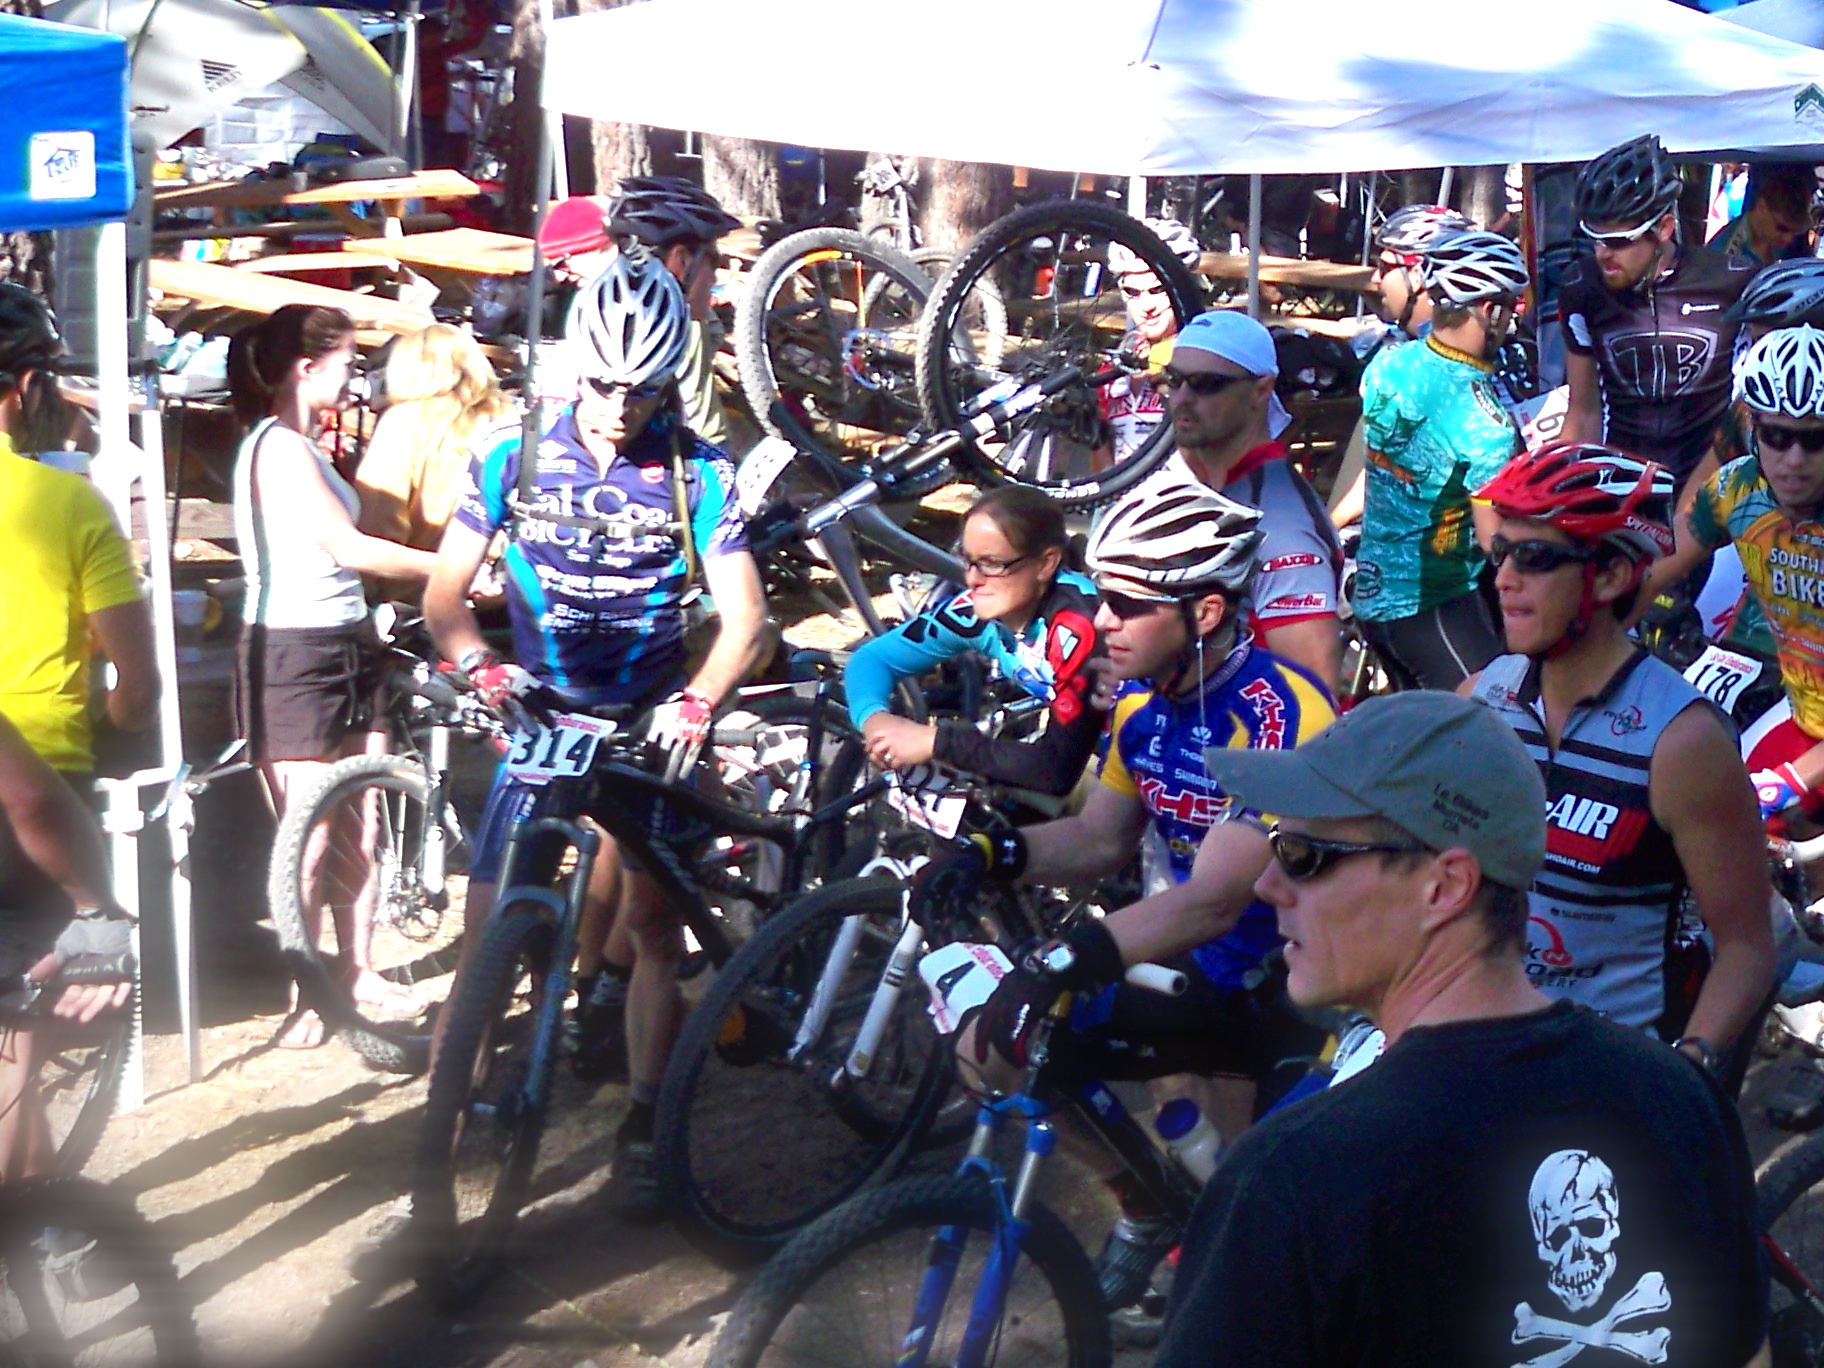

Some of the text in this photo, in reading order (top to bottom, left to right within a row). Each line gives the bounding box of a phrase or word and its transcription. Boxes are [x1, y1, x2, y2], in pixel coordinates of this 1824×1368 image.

[1693, 663, 1742, 706] 178
[511, 728, 595, 773] 314
[1134, 770, 1228, 828] KHS
[1546, 793, 1619, 840] AIR
